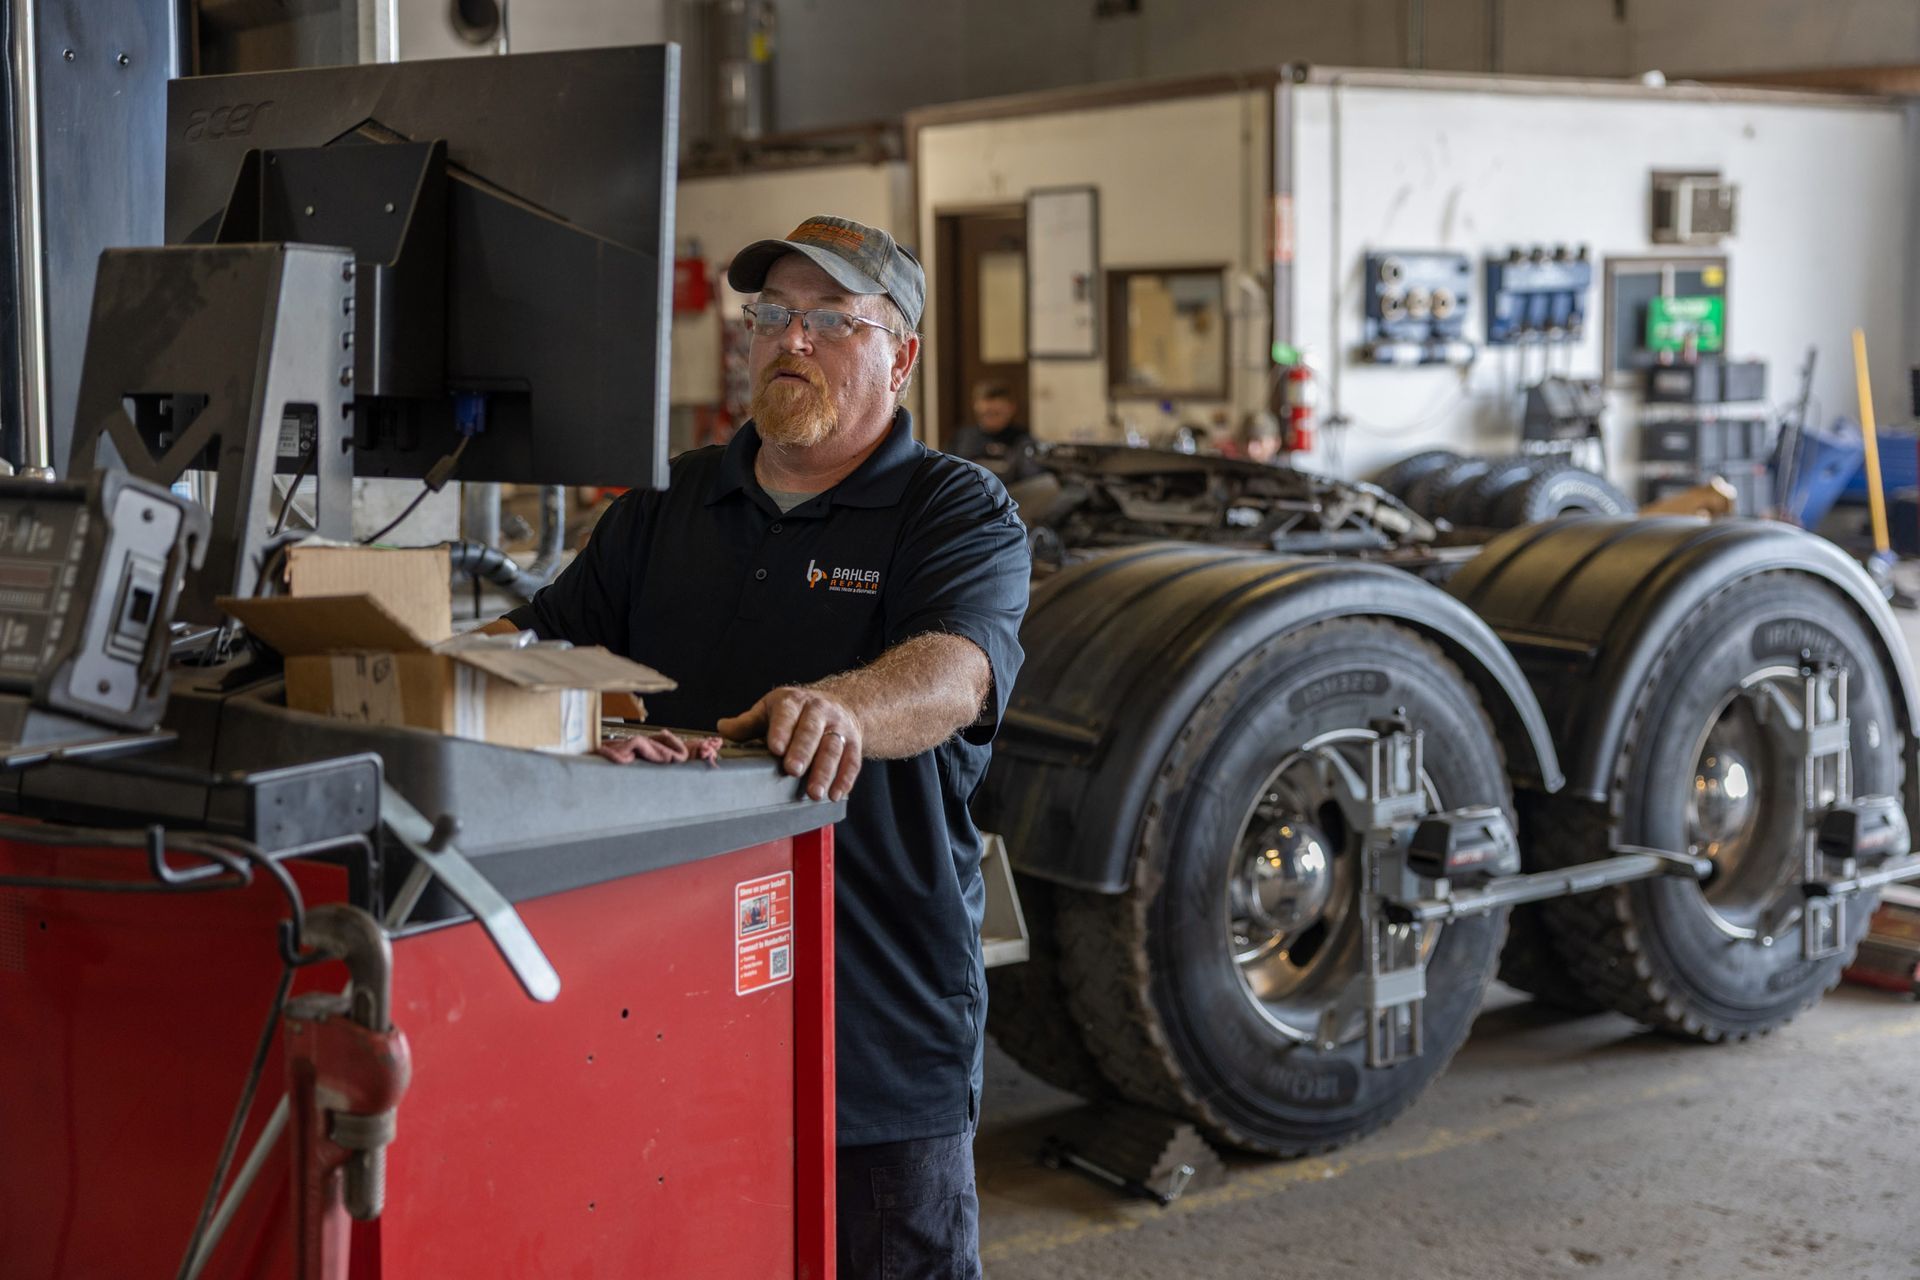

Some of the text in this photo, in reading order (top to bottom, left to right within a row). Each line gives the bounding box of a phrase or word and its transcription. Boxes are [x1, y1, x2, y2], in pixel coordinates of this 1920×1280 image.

[184, 101, 275, 141] acer
[832, 567, 880, 583] BAHLER
[830, 579, 878, 591] REPAIR
